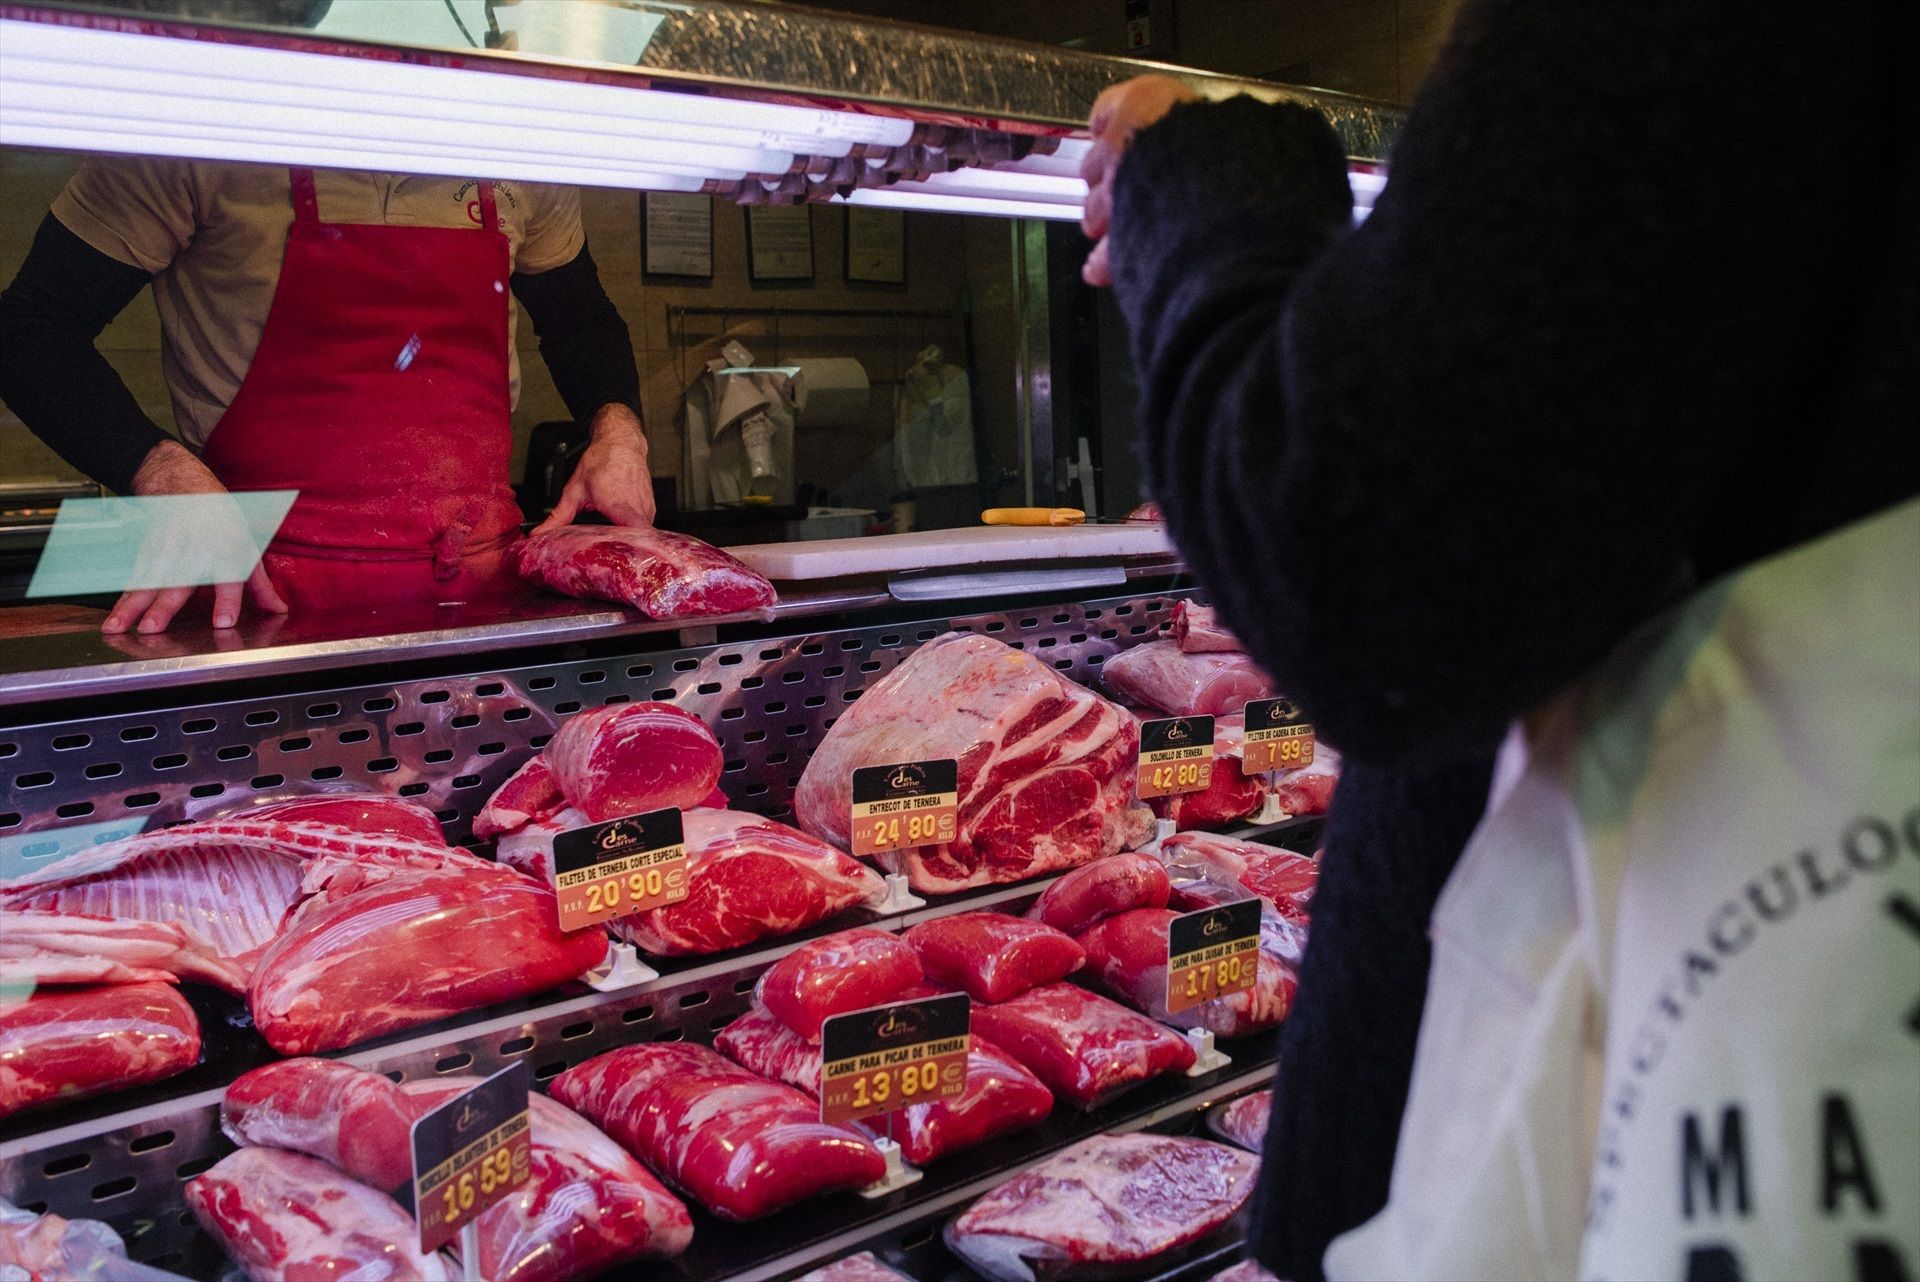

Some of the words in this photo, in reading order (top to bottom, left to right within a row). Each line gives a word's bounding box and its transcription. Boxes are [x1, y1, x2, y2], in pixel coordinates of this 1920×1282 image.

[1265, 730, 1272, 738] DE
[1176, 750, 1182, 759] DE
[1183, 748, 1203, 758] TERNERA
[869, 800, 901, 814] ENTRECOT
[903, 799, 911, 810] DE
[913, 796, 941, 808] TERNERA
[559, 873, 585, 887] FILETES
[588, 868, 597, 879] DE
[599, 862, 628, 877] TERNERA
[630, 856, 651, 869] CORTE
[653, 848, 683, 863] ESPECIAL
[1172, 956, 1189, 970] CARNE
[1190, 952, 1203, 964] PARA
[1225, 944, 1232, 955] DE
[1234, 938, 1257, 953] TERNERA
[827, 1060, 856, 1077] CARNE
[859, 1055, 881, 1071] PARA
[884, 1050, 909, 1065] PICAR
[912, 1046, 923, 1059] DE
[927, 1039, 964, 1056] TERNERA
